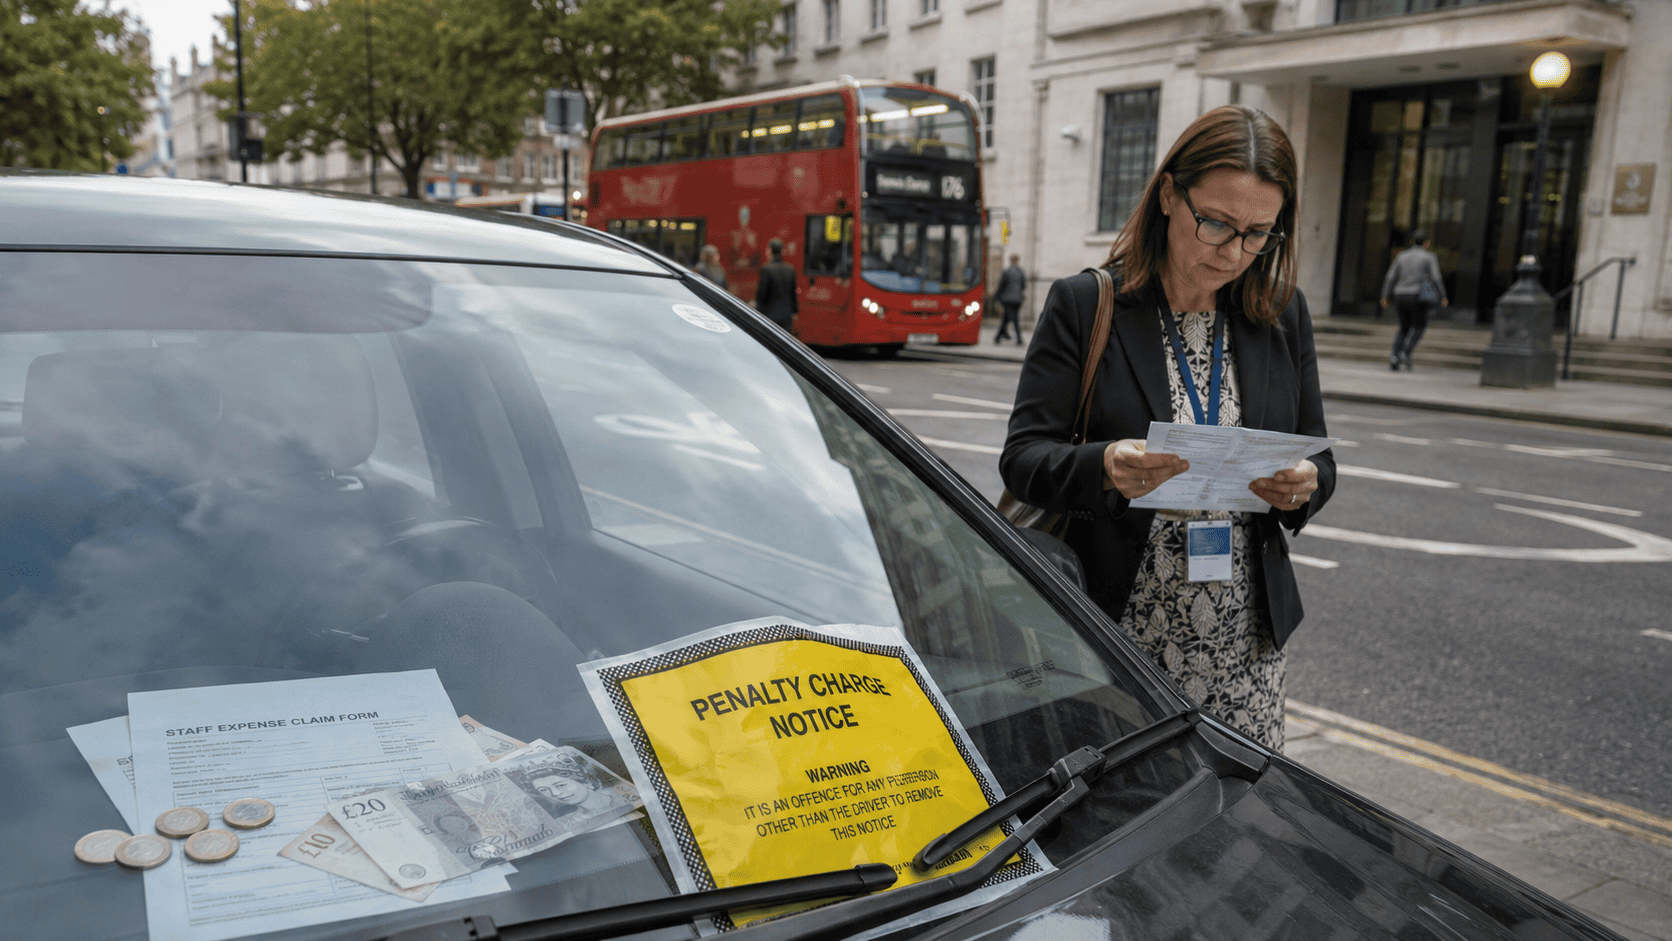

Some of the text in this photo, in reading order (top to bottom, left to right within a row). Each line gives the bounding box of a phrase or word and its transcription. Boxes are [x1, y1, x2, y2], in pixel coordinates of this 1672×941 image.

[690, 673, 892, 721] PENALTY CHARGE
[166, 711, 379, 737] STAFF EXPENSE CLAIM FORM
[769, 704, 859, 739] NOTICE
[805, 759, 871, 784] WARNING
[341, 798, 386, 820] £20
[744, 806, 756, 820] IT
[758, 802, 772, 817] IS
[773, 798, 790, 813] AN
[790, 787, 841, 809] OFFENCE
[842, 782, 866, 798] FOR
[866, 777, 886, 794] ANY
[756, 785, 944, 838] OTHER THAN THE DRIVER TO REMOVE
[830, 814, 897, 841] THIS NOTICE
[297, 833, 336, 858] £10
